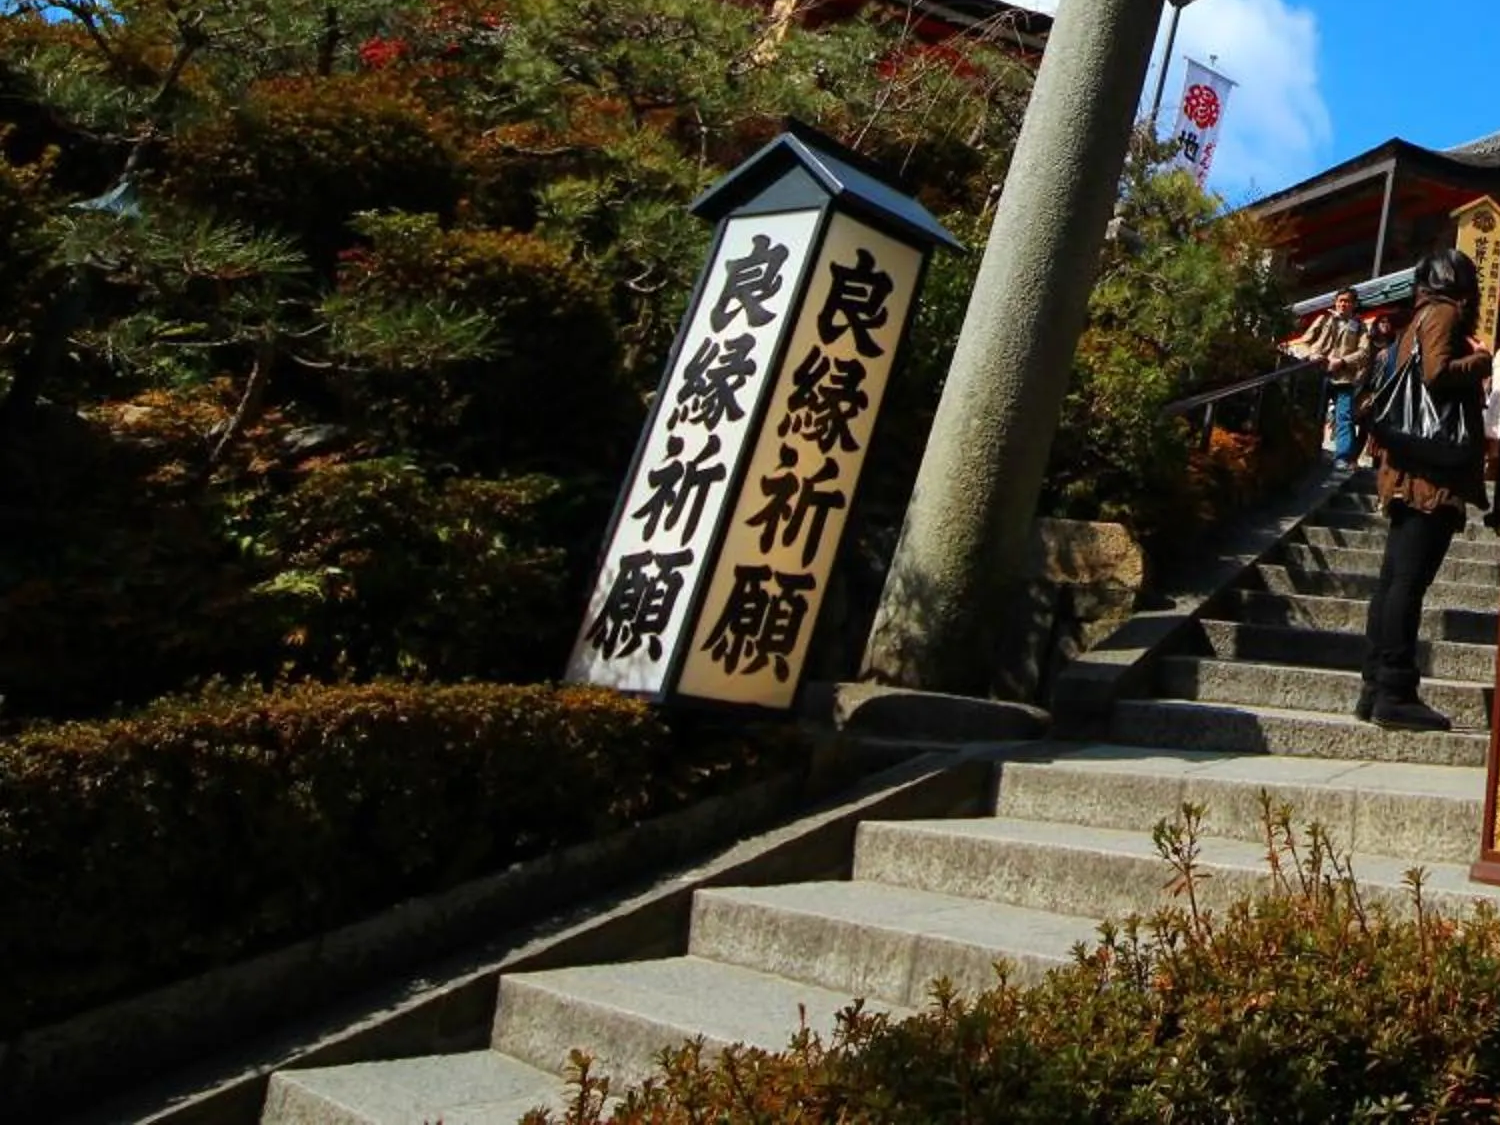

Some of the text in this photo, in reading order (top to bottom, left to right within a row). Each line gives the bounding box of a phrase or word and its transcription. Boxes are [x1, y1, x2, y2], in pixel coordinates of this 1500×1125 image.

[584, 234, 791, 661] 良縁祈願
[700, 248, 895, 683] 良縁祈願
